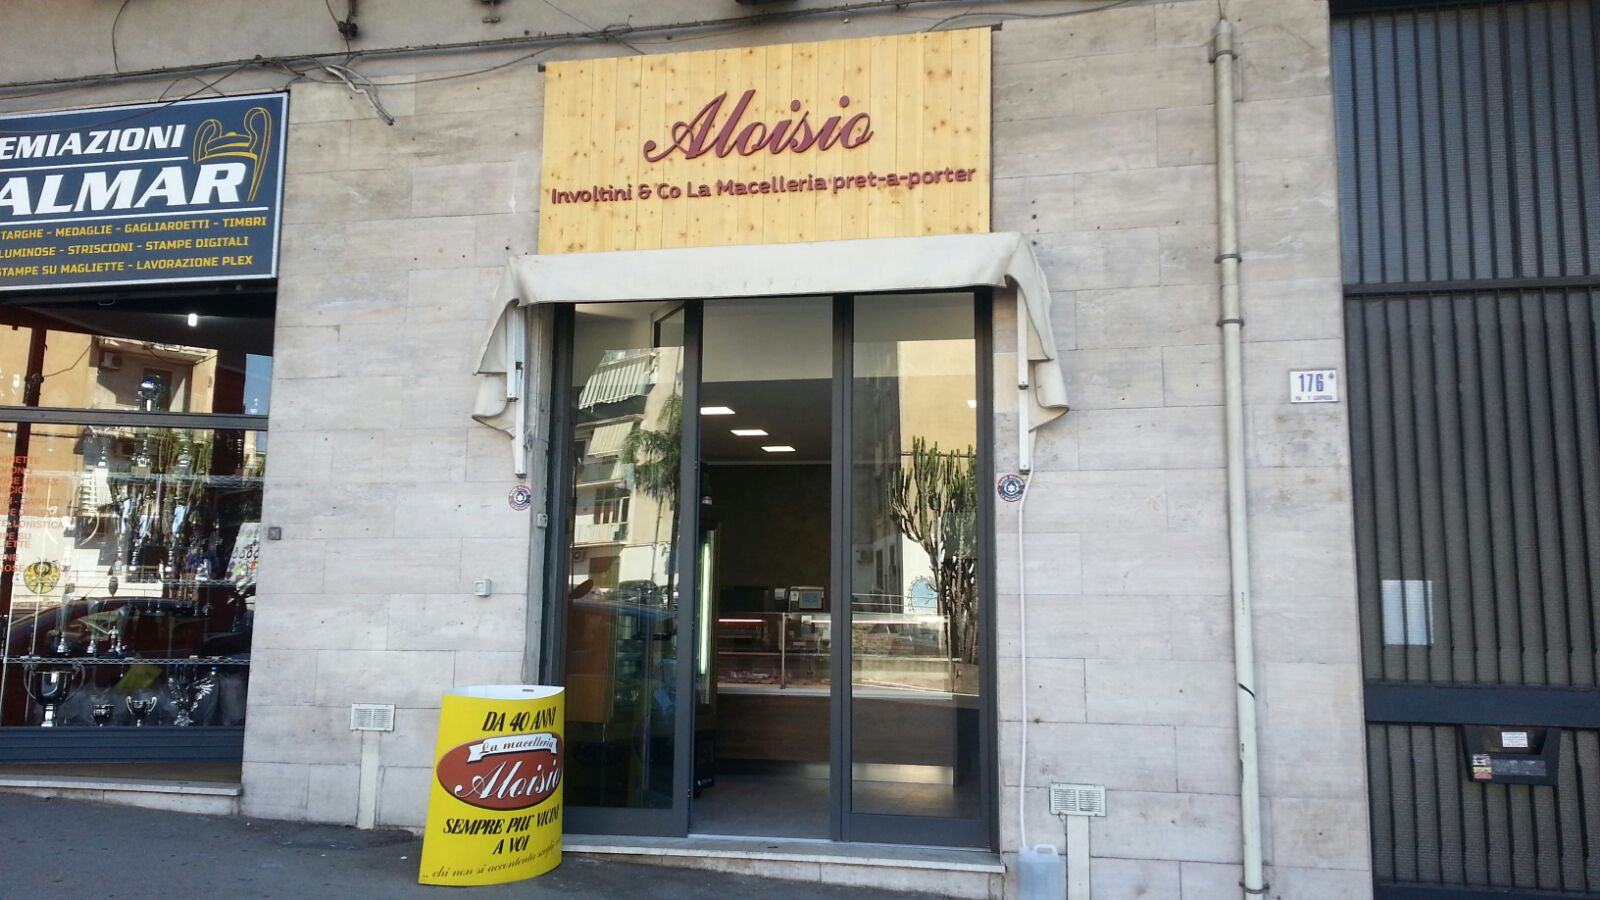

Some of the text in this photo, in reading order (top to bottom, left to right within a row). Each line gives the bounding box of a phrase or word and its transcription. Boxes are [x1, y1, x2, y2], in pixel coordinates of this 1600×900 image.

[643, 89, 874, 163] Aloisio
[0, 162, 246, 216] ALMAR
[551, 165, 976, 205] Involtini & Co La Macelleria pret-a-porter
[1, 227, 44, 240] TARGHE
[55, 224, 112, 238] MEDAGLIE
[124, 219, 210, 233] GAGLIARDETTI
[222, 216, 268, 228] TIMBRI
[0, 246, 56, 258] LUMINOSE
[67, 243, 134, 256] STRISCIONI
[145, 240, 192, 251] STAMPE
[195, 236, 249, 248] DIGITALI
[0, 266, 38, 277] TAMPE
[42, 265, 57, 276] SU
[61, 261, 125, 274] MAGLIETTE
[136, 256, 218, 270] LAVORAZIONE
[222, 255, 253, 266] PLEX
[1298, 373, 1324, 392] 176
[482, 706, 557, 732] DA 40 ANNI
[502, 736, 554, 750] macelleria
[454, 758, 564, 800] Aloisio
[443, 817, 506, 836] SEMPRE
[536, 804, 560, 828] VICINI
[492, 834, 530, 855] A VOI
[432, 865, 450, 878] chi
